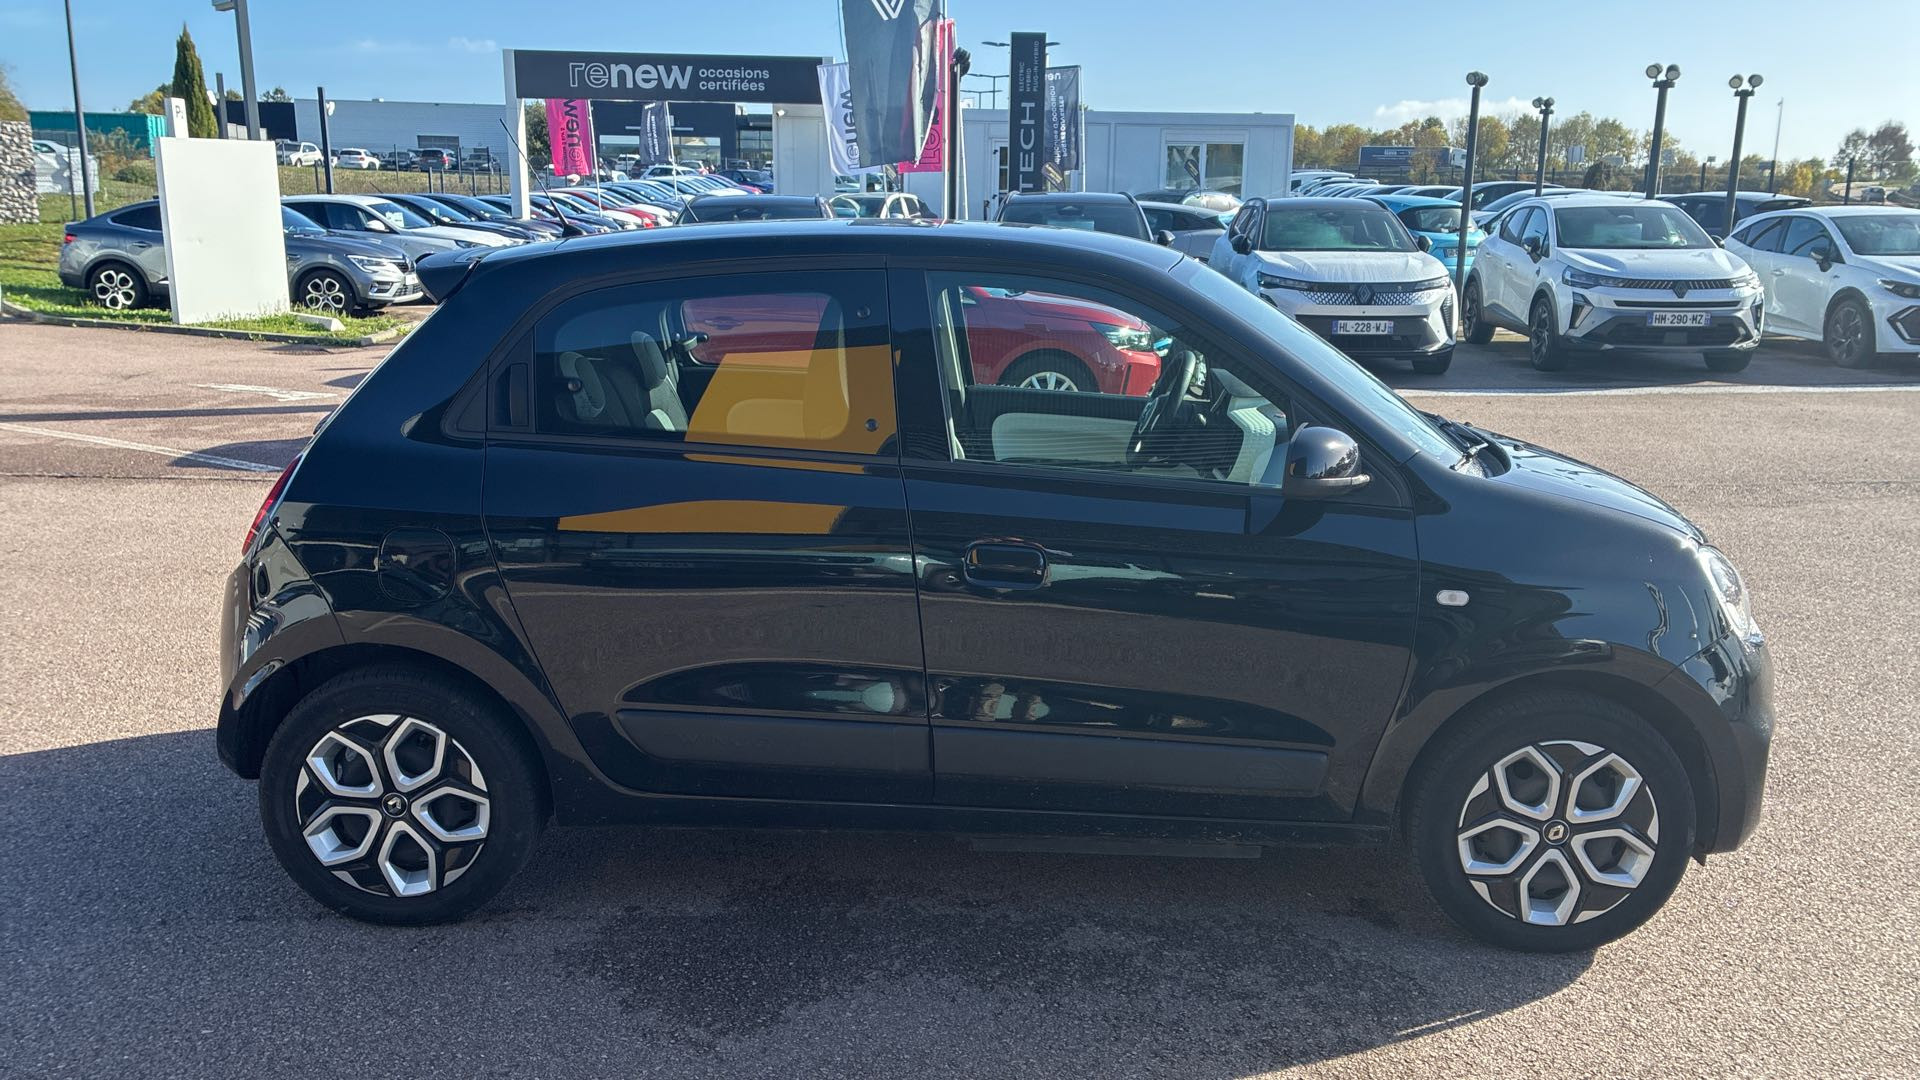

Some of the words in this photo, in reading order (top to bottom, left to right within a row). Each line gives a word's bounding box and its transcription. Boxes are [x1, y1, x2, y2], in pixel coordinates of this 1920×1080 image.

[569, 62, 693, 90] renew
[699, 66, 770, 79] occasions
[699, 79, 765, 91] certifiées
[1019, 102, 1036, 193] TECH
[1339, 322, 1387, 333] HL-228-WJ
